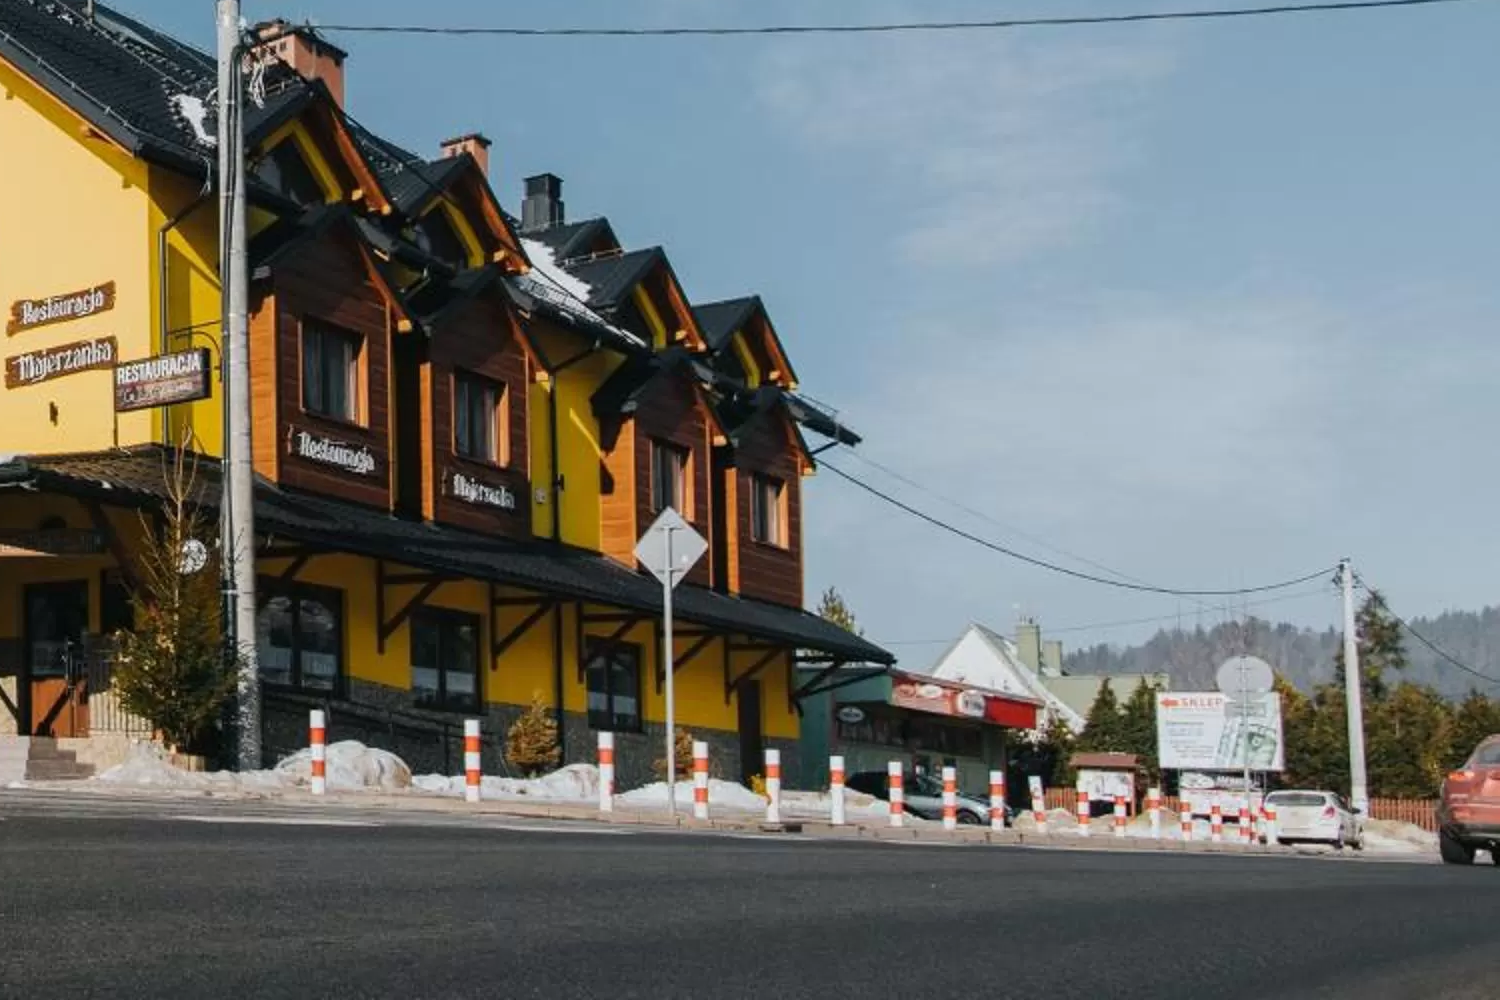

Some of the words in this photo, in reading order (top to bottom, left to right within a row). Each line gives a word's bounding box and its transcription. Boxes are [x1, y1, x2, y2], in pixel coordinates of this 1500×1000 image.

[22, 287, 104, 324] Restauracja
[12, 339, 112, 382] Majerzanka
[117, 353, 201, 384] RESTAURACJA
